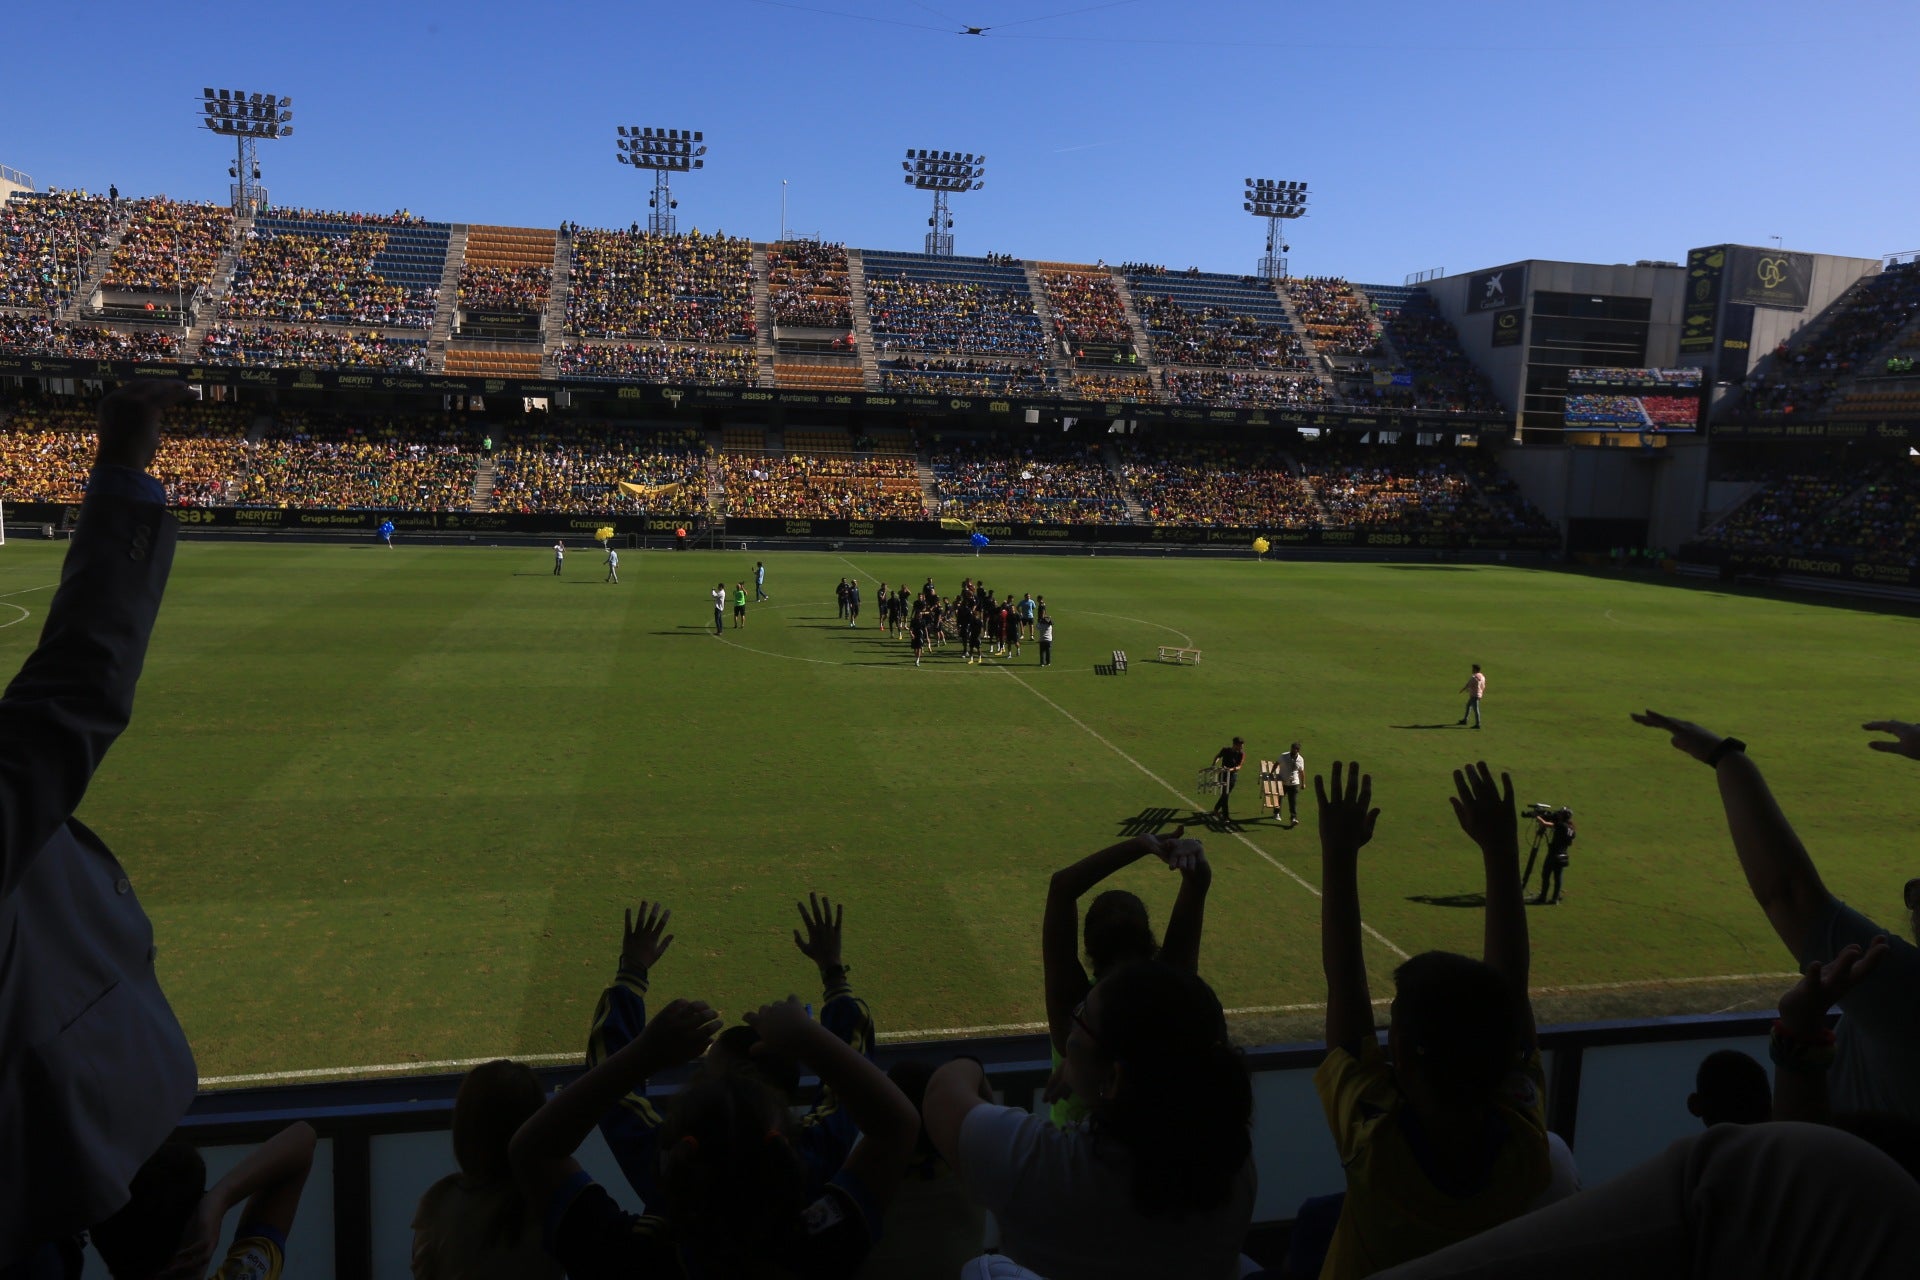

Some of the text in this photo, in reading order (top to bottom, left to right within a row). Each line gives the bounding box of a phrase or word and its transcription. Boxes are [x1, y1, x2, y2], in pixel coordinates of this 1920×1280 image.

[480, 315, 500, 323] Grupo
[339, 375, 373, 384] ENERYETI
[742, 392, 768, 400] asisa
[866, 397, 890, 405] asisa
[960, 401, 972, 409] bp
[235, 510, 282, 521] ENERYETI
[301, 514, 329, 525] Grupo
[570, 519, 617, 530] Cruzcampo
[786, 527, 812, 535] Capital
[849, 528, 875, 536] Capital
[1028, 528, 1069, 537] Cruzcampo
[1367, 533, 1402, 545] asisa
[1787, 557, 1841, 574] macron
